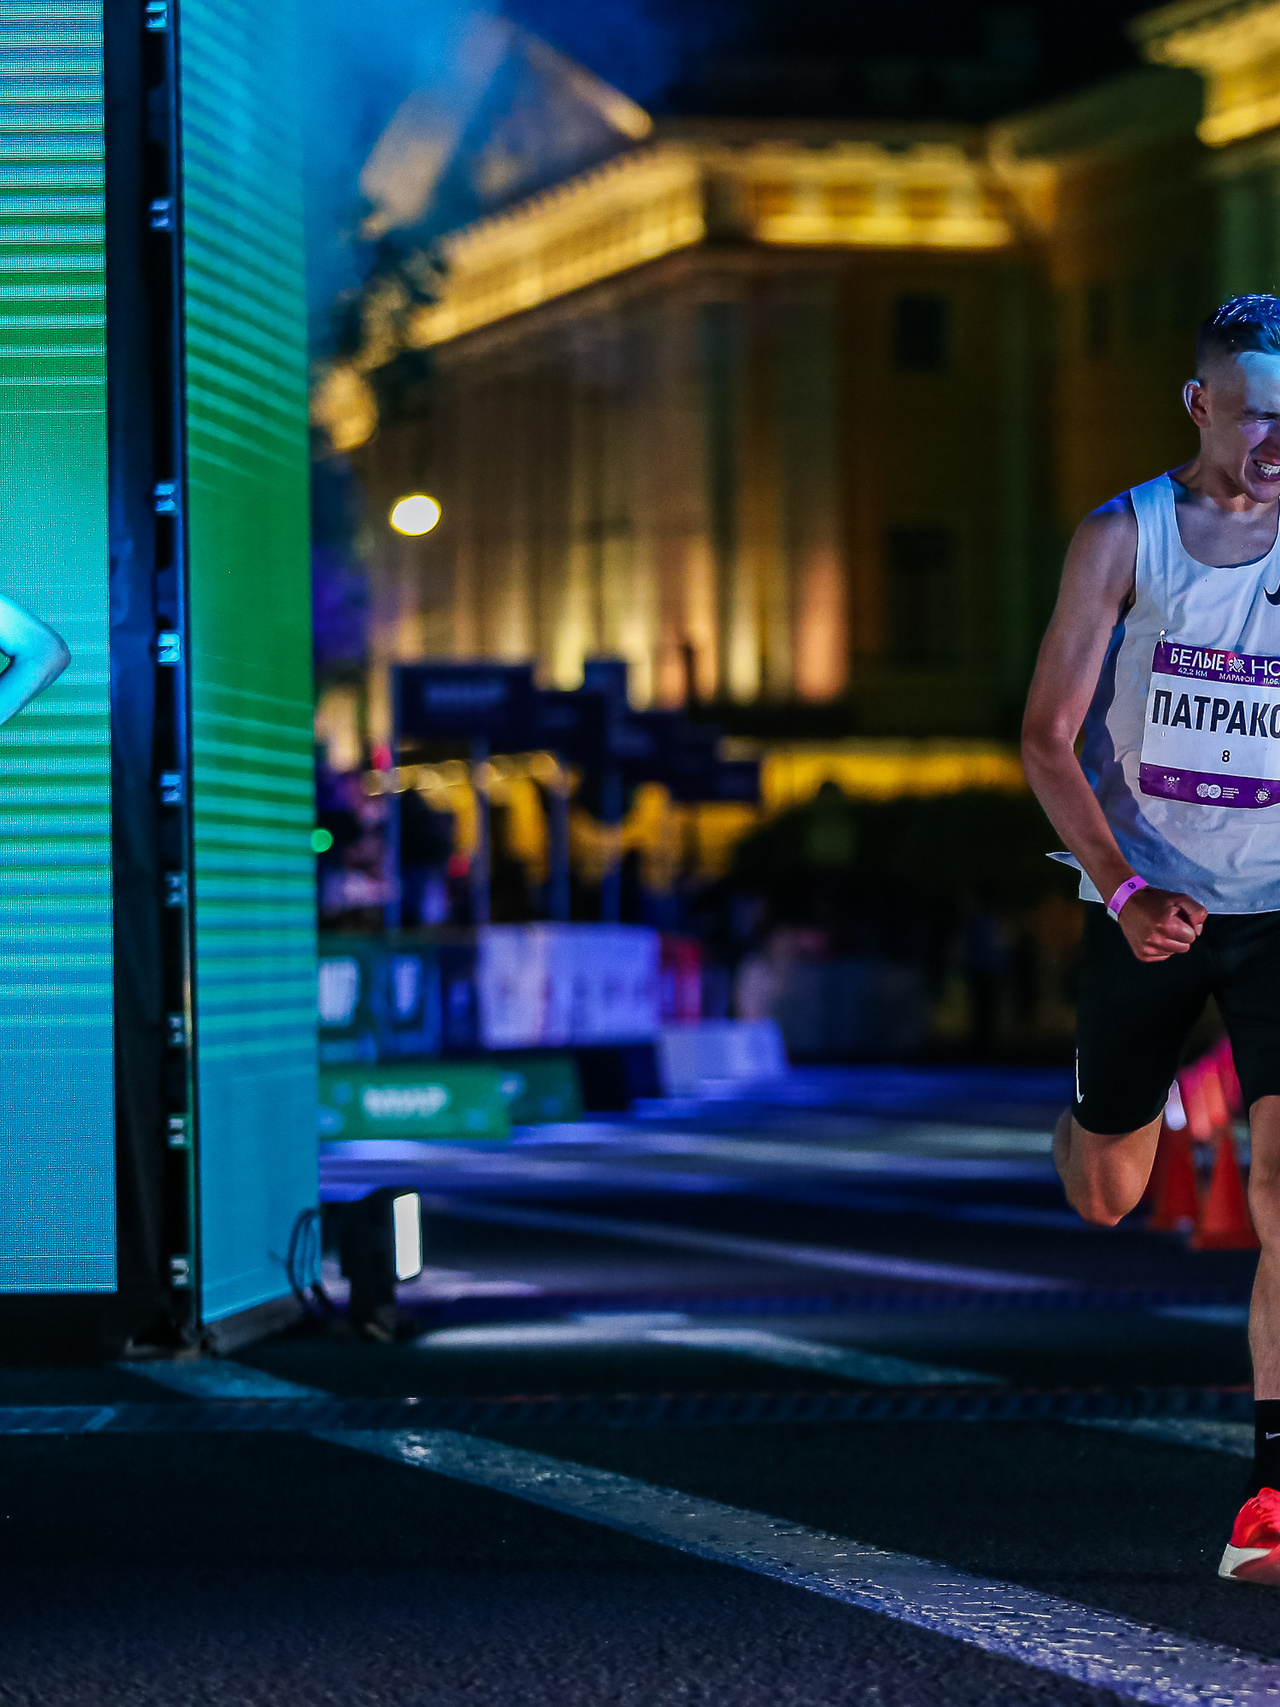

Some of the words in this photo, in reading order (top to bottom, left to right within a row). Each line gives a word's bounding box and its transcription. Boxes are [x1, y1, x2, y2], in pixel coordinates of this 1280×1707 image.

[1170, 647, 1225, 671] БЕЛЫЕ
[1195, 669, 1208, 677] КМ
[1219, 673, 1255, 683] МАРАФОН
[1221, 750, 1230, 763] 8
